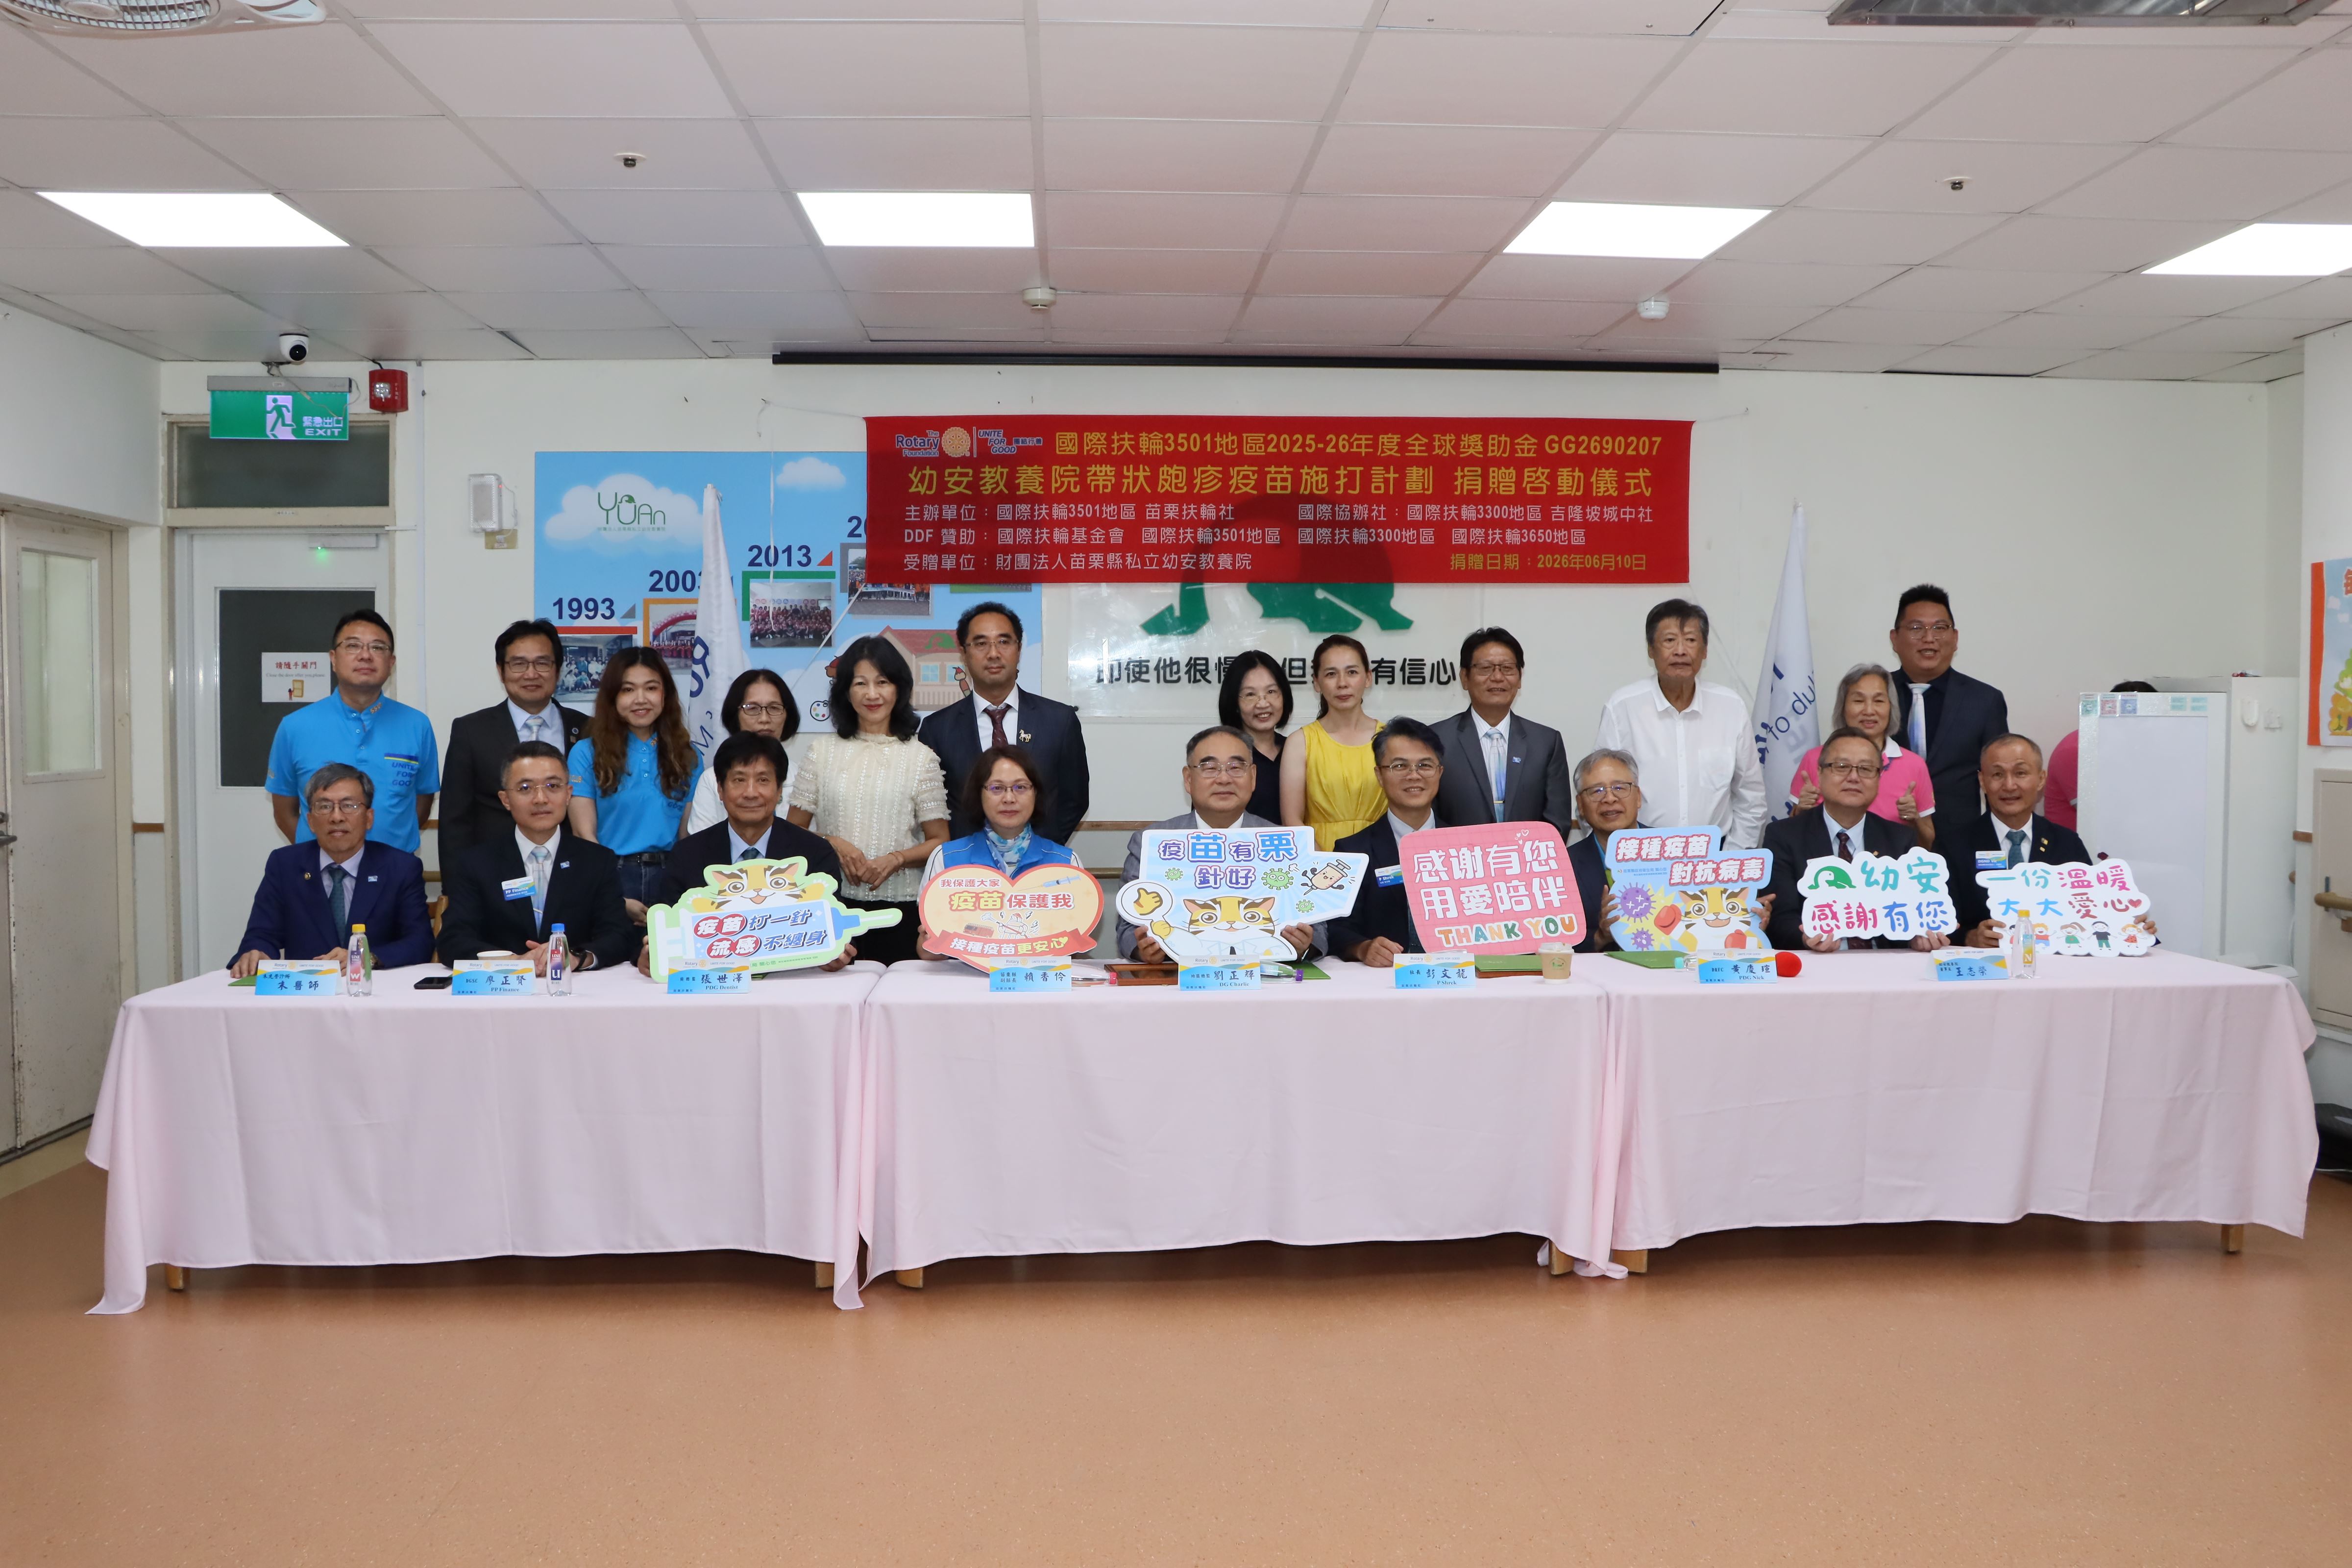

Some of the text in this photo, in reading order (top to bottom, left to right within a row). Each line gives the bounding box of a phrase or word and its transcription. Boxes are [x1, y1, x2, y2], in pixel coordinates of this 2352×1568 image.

[303, 416, 343, 427] 緊急出口
[896, 435, 939, 449] Rotary
[1056, 431, 1662, 457] 國際扶輪3501地區2025-26年度全球獎助金 GG2690207
[908, 465, 1434, 495] 幼安教養院帶狀皰疹疫苗施打計劃
[1145, 503, 1235, 520] 苗栗扶輪社
[1550, 505, 1653, 522] 吉隆坡城中社
[905, 528, 933, 542] DDF
[1142, 527, 1281, 544] 國際扶輪3501地區
[1298, 528, 1435, 544] 國際扶輪3300地區
[1451, 528, 1586, 545] 國際扶輪3650地區
[747, 545, 811, 567] 2013
[648, 569, 701, 592] 200
[553, 597, 615, 620] 1993
[1281, 657, 1456, 685] 但有信心
[392, 762, 415, 771] UNITE
[1159, 831, 1298, 862] 疫苗有栗
[1616, 834, 1710, 861] 接種疫苗
[940, 878, 1001, 888] 我保護大家
[1195, 865, 1256, 889] 針好
[1670, 858, 1764, 885] 對抗病毒
[1861, 857, 1939, 894] 幼安
[1986, 865, 2131, 891] 一份溫暖
[949, 890, 1074, 910] 疫苗保護我
[1420, 876, 1568, 920] 用愛陪伴
[1998, 892, 2130, 919] 大大愛心
[696, 909, 812, 936] 疫苗打一針
[1812, 900, 1948, 934] 感謝有您
[1437, 915, 1576, 946] THANK YOU
[709, 930, 827, 958] 流感不纏身
[950, 937, 1064, 955] 接種疫苗更安心
[486, 975, 526, 985] 廖正賢
[701, 973, 743, 984] 張世澤
[1024, 972, 1066, 982] 賴香伶
[1426, 968, 1468, 979] 彭文龍
[1956, 966, 1987, 977] 王志榮
